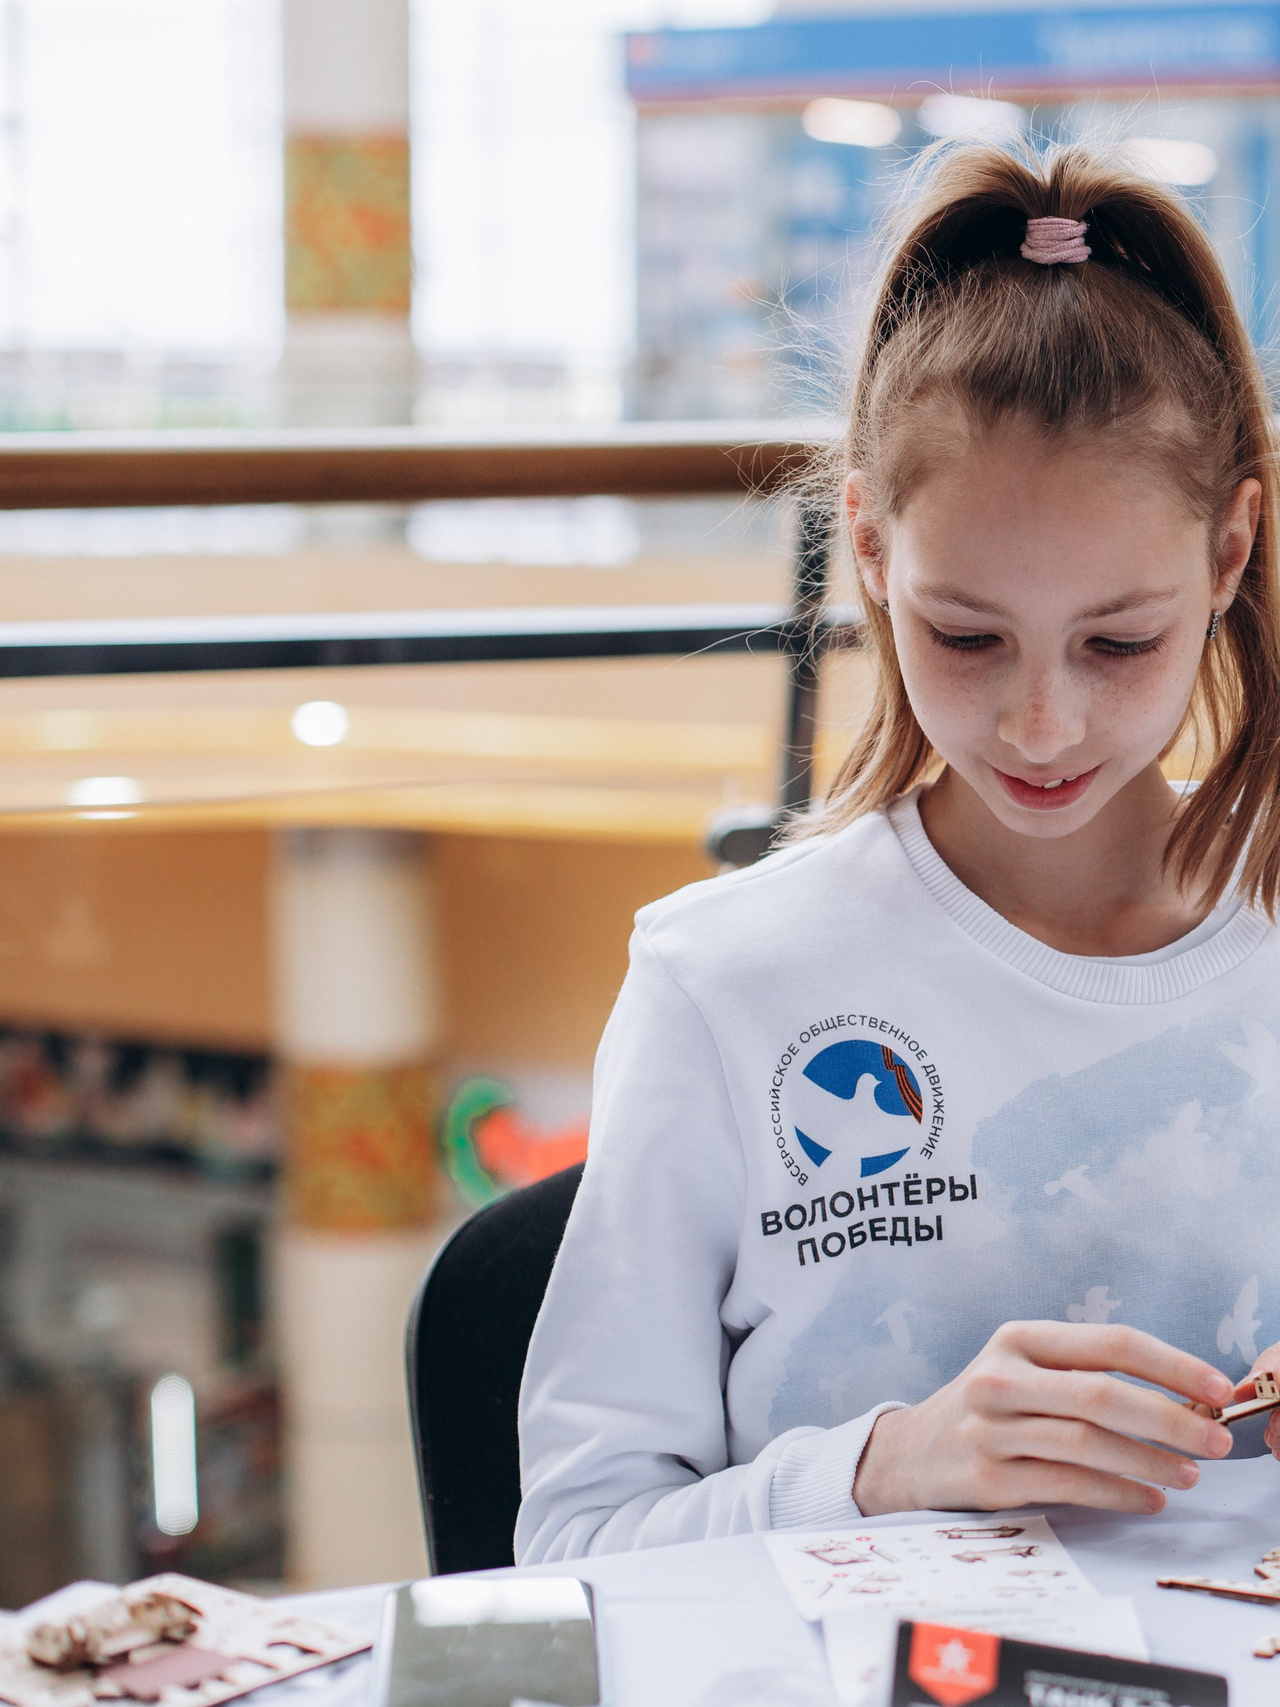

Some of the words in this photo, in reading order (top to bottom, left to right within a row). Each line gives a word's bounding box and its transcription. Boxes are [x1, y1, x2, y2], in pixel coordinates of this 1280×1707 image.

[769, 1043, 809, 1187] ВСЕРОССИЙСКОЕ
[800, 1014, 928, 1061] ОБЩЕСТВЕННОЕ
[920, 1063, 945, 1160] ДВИЖЕНИЕ
[761, 1173, 978, 1236] ВОЛОНТЁРЫ
[797, 1215, 943, 1266] ПОБЕДЫ
